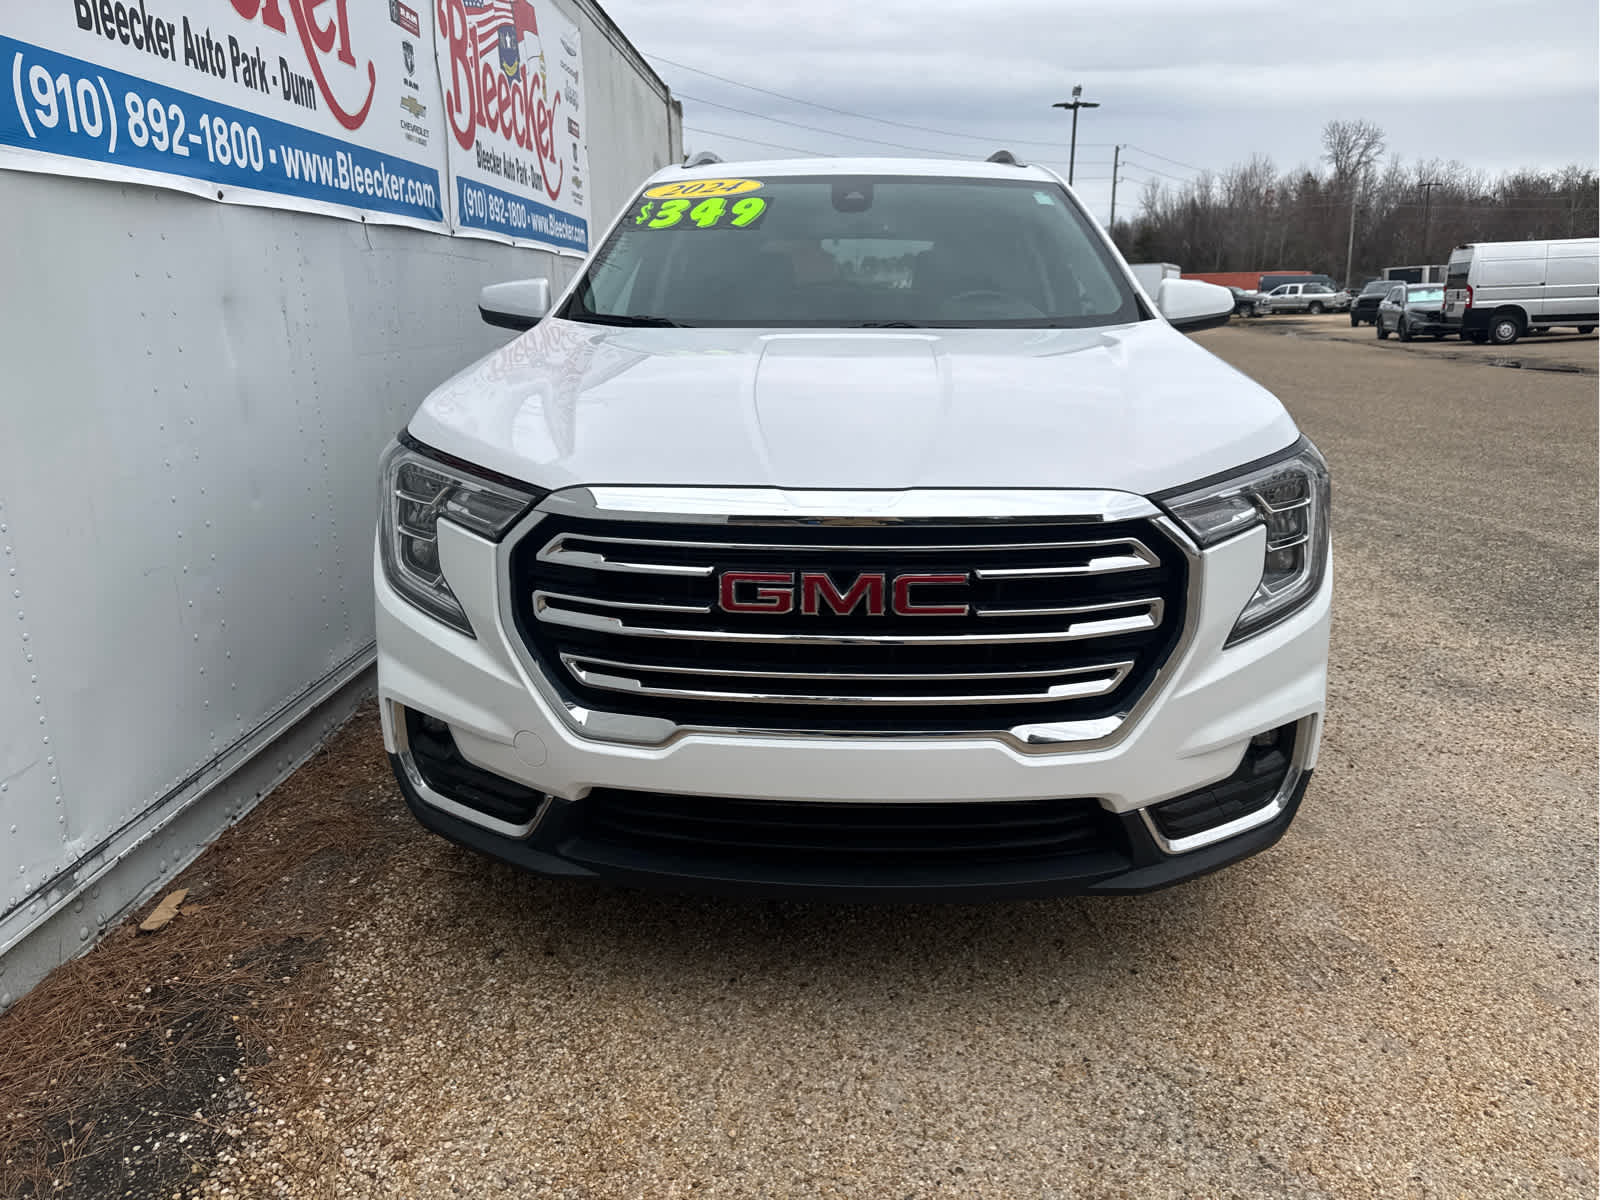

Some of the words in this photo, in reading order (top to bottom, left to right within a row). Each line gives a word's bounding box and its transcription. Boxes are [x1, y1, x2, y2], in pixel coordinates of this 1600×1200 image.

[183, 16, 226, 79] Auto
[228, 35, 270, 94] Park
[279, 56, 317, 111] Dunn
[13, 52, 117, 153] (910)
[125, 92, 263, 172] 892-1800
[280, 145, 435, 208] www.Bleecker.com
[437, 0, 563, 200] Bleecker
[476, 139, 502, 176] Bleecker
[503, 152, 516, 182] Auto
[516, 157, 528, 186] Park
[661, 181, 746, 196] 2024
[463, 183, 487, 224] (910)
[488, 194, 527, 229] 892-1800
[531, 212, 586, 244] www.Bleecker.com
[718, 570, 970, 616] GMC
